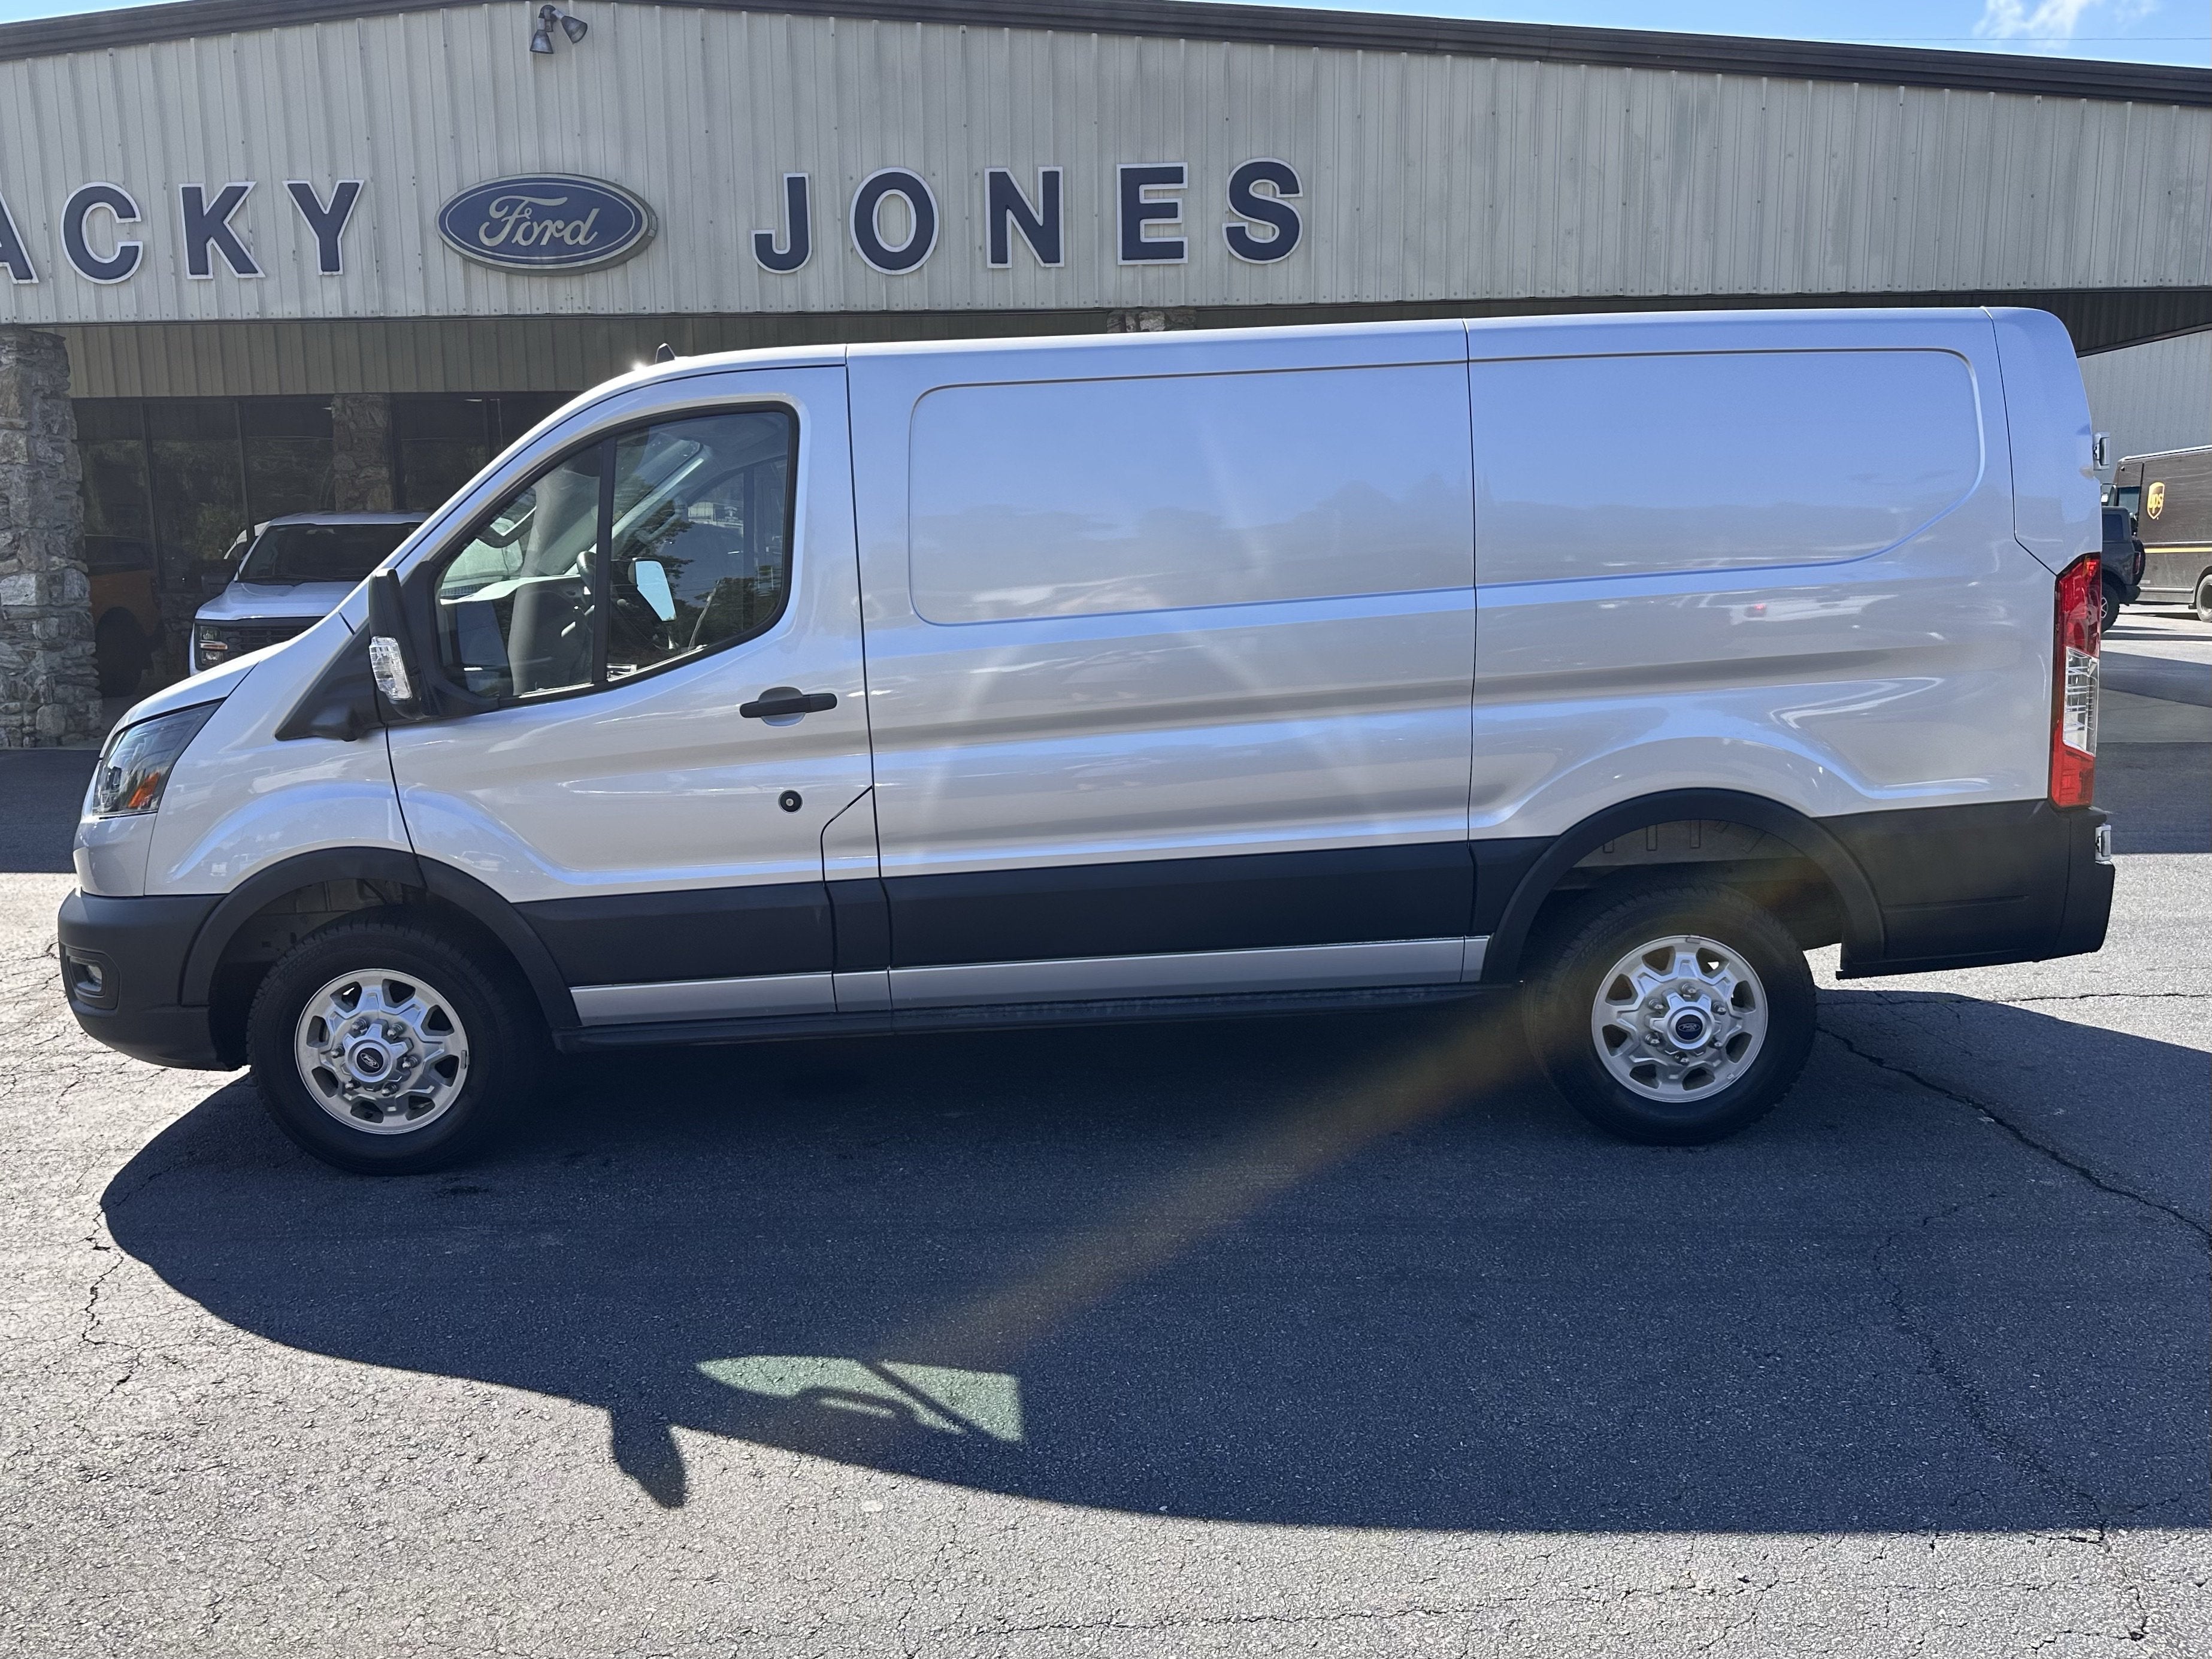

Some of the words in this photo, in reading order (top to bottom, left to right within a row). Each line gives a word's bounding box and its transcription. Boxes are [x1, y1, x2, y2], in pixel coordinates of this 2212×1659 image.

[479, 195, 600, 247] Ford
[751, 157, 1304, 276] JONES
[2149, 493, 2163, 514] ups
